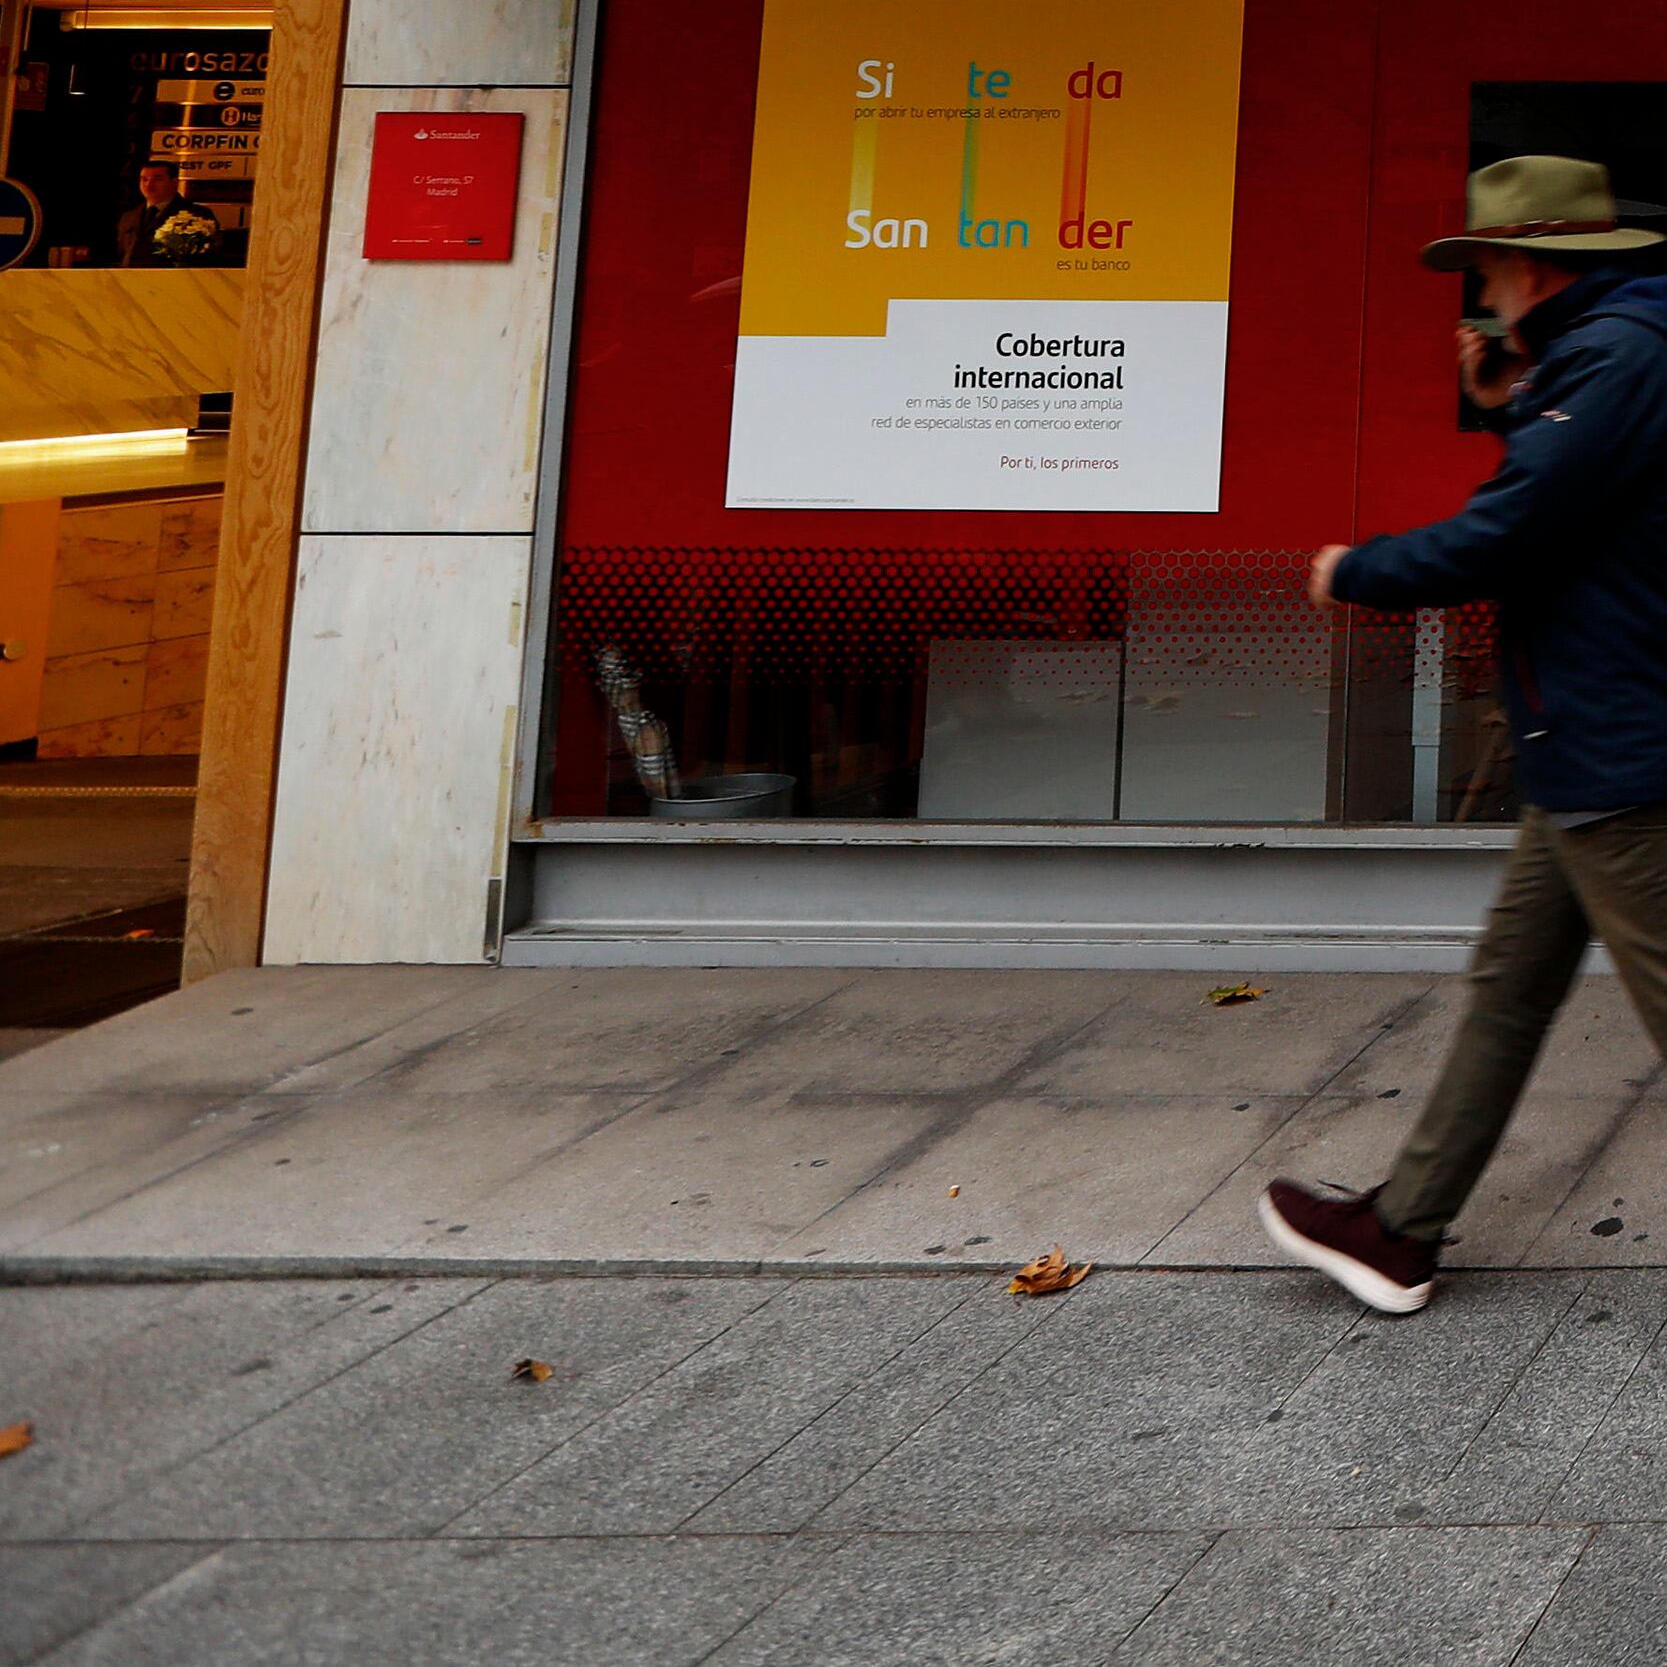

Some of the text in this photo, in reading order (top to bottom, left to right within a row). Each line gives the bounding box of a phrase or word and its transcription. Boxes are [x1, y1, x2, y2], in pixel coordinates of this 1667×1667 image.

[855, 60, 1123, 100] Si te da
[854, 106, 1060, 121] por abrir tu empresa al extranjero
[162, 134, 248, 149] CORPFIN
[429, 129, 481, 140] Santander
[426, 188, 458, 197] Madrid
[844, 209, 1133, 250] San tan der
[1057, 258, 1130, 271] es tu banco
[996, 333, 1125, 357] Cobertura
[954, 364, 1124, 390] internacional
[906, 398, 921, 408] en
[955, 396, 971, 409] de
[976, 396, 998, 409] 150
[1042, 399, 1051, 411] y
[1054, 399, 1077, 410] una
[1080, 397, 1123, 412] amplia
[871, 416, 1122, 431] red de especialistas en comercio exterior
[1000, 455, 1119, 471] Por ti, los primeros
